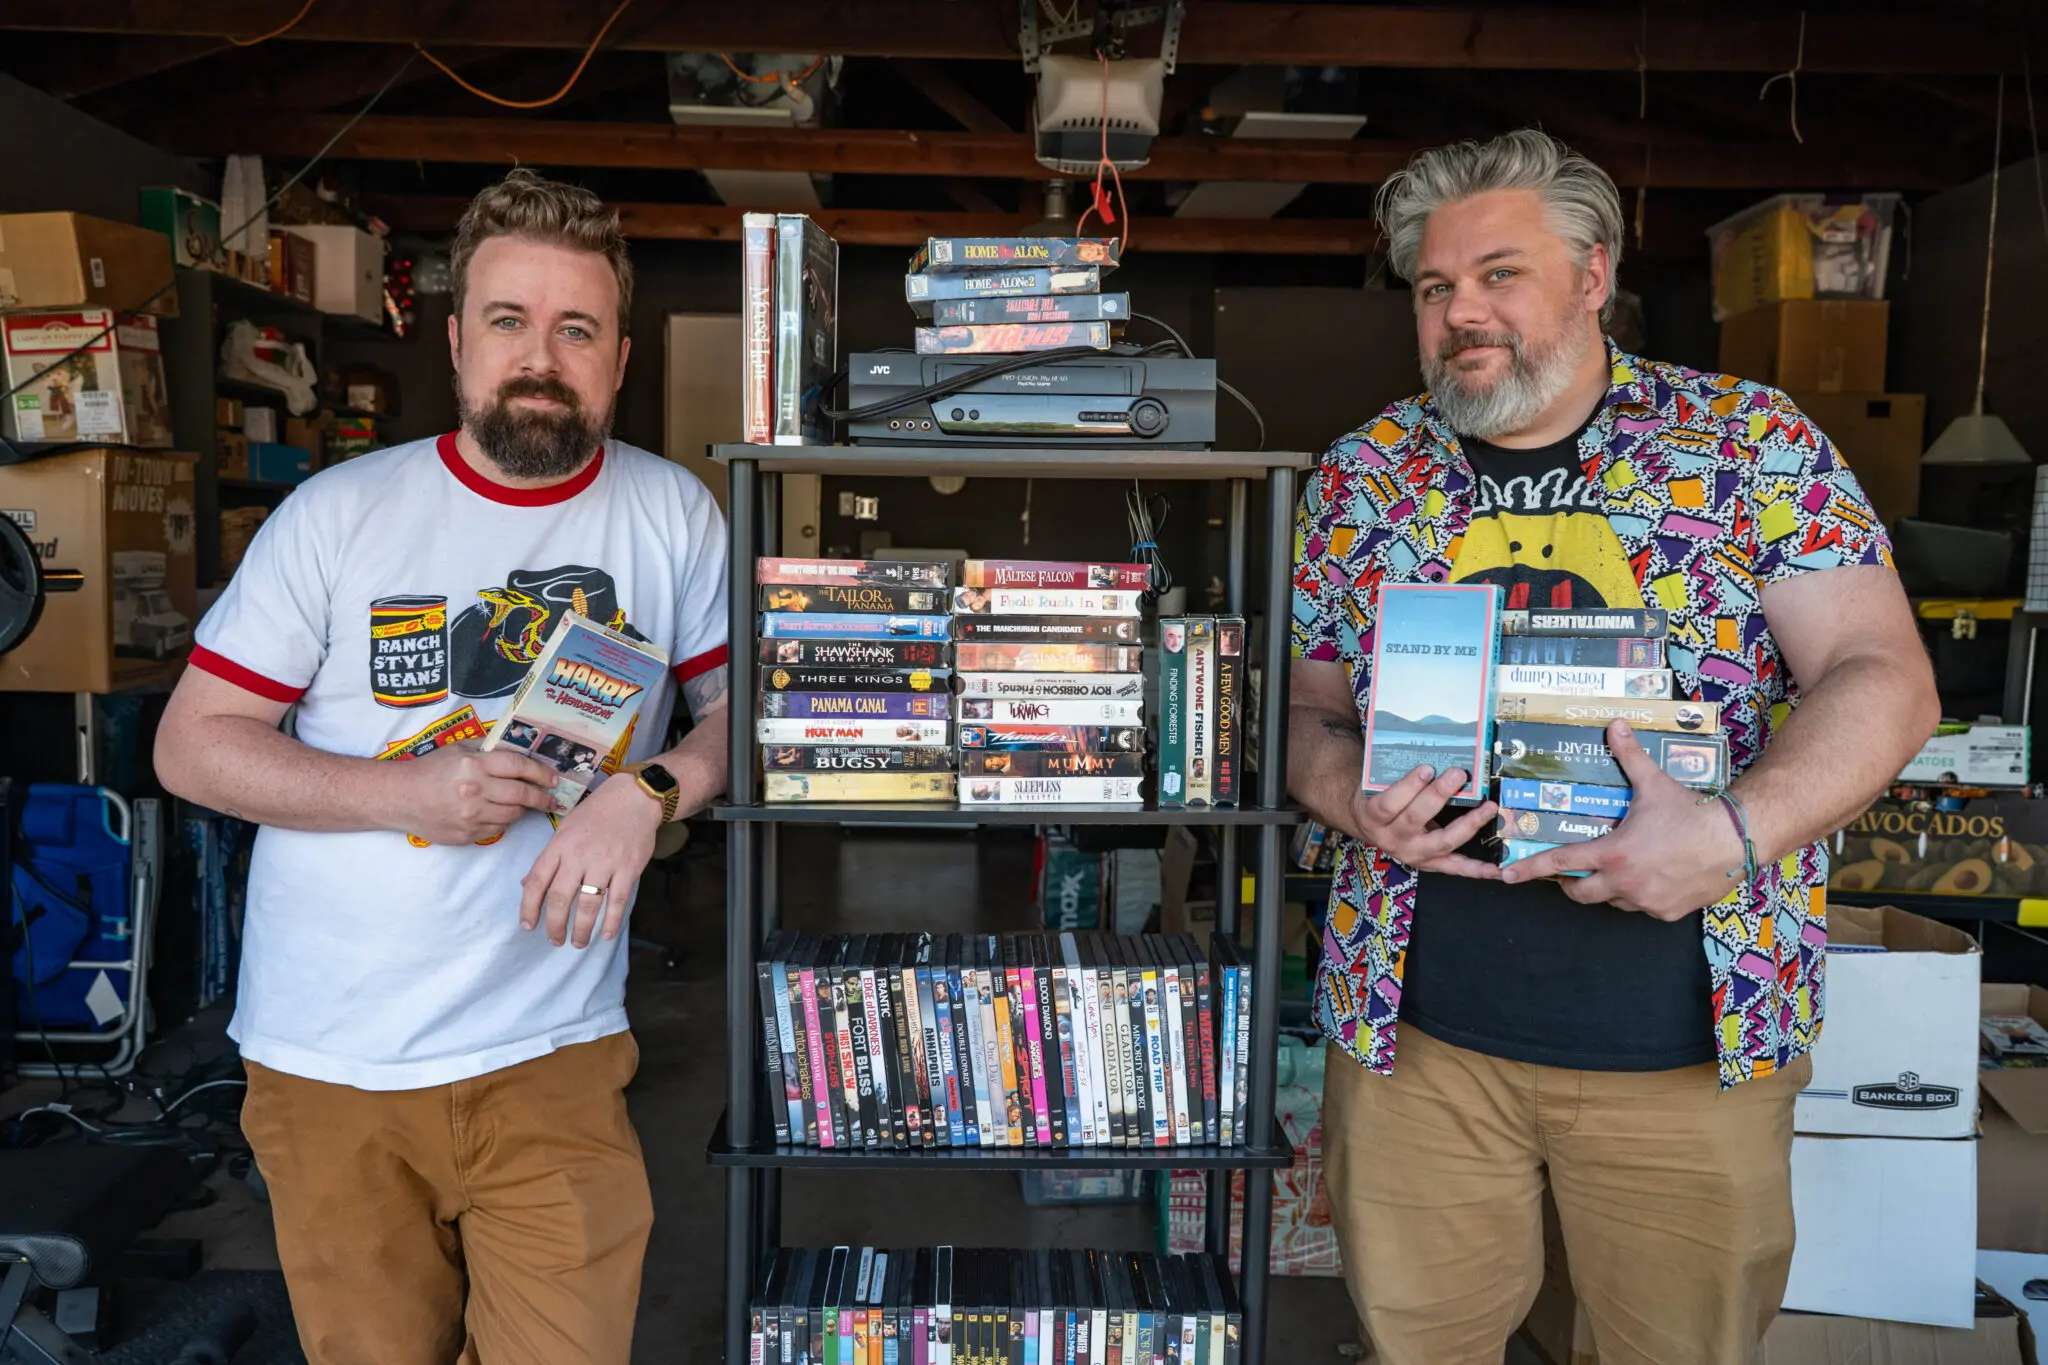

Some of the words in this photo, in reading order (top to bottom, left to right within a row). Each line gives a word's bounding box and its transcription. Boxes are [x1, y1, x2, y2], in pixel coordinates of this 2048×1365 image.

[964, 245, 999, 259] HOME
[964, 278, 992, 289] HOME
[1006, 300, 1039, 313] FUGITIVE
[1041, 298, 1055, 312] THE
[987, 326, 1073, 347] SPEED
[870, 365, 890, 375] JVC
[112, 484, 165, 513] MOVES
[995, 568, 1037, 584] MALTESE
[1038, 571, 1075, 587] FALCON
[826, 587, 883, 603] TAILOR
[1000, 595, 1034, 607] Fools
[1039, 596, 1074, 608] Rush
[1080, 597, 1094, 608] In
[848, 600, 895, 610] PANAMA
[993, 625, 1040, 633] MANCHURIAN
[1041, 625, 1083, 633] CANDIDATE
[1532, 615, 1635, 630] WINDTALKERS
[378, 635, 440, 653] RANCH
[815, 646, 895, 658] SHAWSHANK
[1386, 643, 1431, 655] STAND
[1433, 645, 1452, 656] BY
[1454, 646, 1478, 657] ME
[374, 650, 446, 670] STYLE
[1221, 662, 1231, 670] A
[377, 668, 441, 687] BEANS
[547, 657, 645, 708] HARRY
[800, 675, 847, 683] THREE
[854, 675, 903, 684] KINGS
[1169, 668, 1178, 702] FINDING
[1195, 649, 1205, 711] ANTWONE
[1221, 671, 1232, 694] FEW
[1510, 668, 1552, 685] Gump
[1556, 670, 1607, 691] Forrest
[998, 682, 1034, 694] Friends
[1035, 685, 1042, 695] &
[1043, 685, 1089, 696] ORBISON
[1090, 686, 1112, 696] ROY
[556, 690, 614, 720] HENDERSONS
[811, 698, 853, 713] PANAMA
[855, 698, 888, 714] CANAL
[1009, 702, 1051, 721] TURNING
[1220, 695, 1231, 731] GOOD
[1565, 706, 1653, 723] SIDEKICKS
[805, 726, 835, 738] HOLY
[836, 728, 863, 738] MAN
[1169, 703, 1178, 745] FORRESTER
[988, 731, 1078, 743] Thunder
[1194, 712, 1204, 756] FISHER
[1220, 732, 1230, 756] MEN
[816, 758, 892, 769] BUGSY
[1048, 754, 1115, 770] MUMMY
[1554, 755, 1610, 766] GIBSON
[1014, 780, 1062, 793] SLEEPLESS
[1575, 796, 1609, 806] BALOO
[1558, 820, 1599, 837] Harry
[1852, 810, 2005, 838] AVOCADOS
[803, 979, 815, 997] he's
[863, 978, 874, 1001] EDGE
[1039, 978, 1050, 1006] BLOOD
[804, 996, 817, 1013] just
[866, 1001, 875, 1009] of
[877, 978, 891, 1018] FRANTIC
[895, 1002, 903, 1017] THE
[1087, 1001, 1098, 1019] Love
[868, 1009, 880, 1056] DARKNESS
[897, 1019, 906, 1037] THIN
[1041, 1007, 1052, 1040] DIAMOND
[1185, 1021, 1194, 1037] THE
[1238, 1015, 1250, 1034] BAD
[809, 1030, 821, 1046] that
[839, 1030, 850, 1051] FIRST
[851, 1017, 866, 1053] FORT
[956, 1024, 967, 1052] DOUBLE
[811, 1047, 822, 1065] into
[900, 1040, 908, 1054] RED
[940, 1032, 955, 1074] SCHOOL
[988, 1041, 997, 1058] One
[1061, 1041, 1070, 1062] HOTEL
[1132, 1024, 1143, 1073] MINORITY
[1150, 1035, 1161, 1066] ROAD
[1200, 1011, 1216, 1101] MECHANIC
[1237, 1034, 1249, 1065] COUNTRY
[796, 1030, 811, 1099] Intouchables
[824, 1032, 839, 1088] STOP-LOSS
[902, 1056, 911, 1074] LINE
[924, 1028, 941, 1087] ANNAPOLIS
[1029, 1040, 1039, 1079] ANGELS
[1105, 1024, 1119, 1097] GLADIATOR
[1121, 1024, 1134, 1097] GLADIATOR
[812, 1065, 823, 1081] you
[842, 1050, 856, 1090] SNOW
[856, 1056, 872, 1097] BLISS
[960, 1052, 971, 1087] JEOPARDY
[990, 1060, 999, 1085] Day
[1015, 1045, 1034, 1114] SPIRIT
[1063, 1065, 1077, 1097] RWANDA
[1152, 1068, 1163, 1093] TRIP
[1136, 1076, 1147, 1111] REPORT
[1860, 1092, 1923, 1102] BANKERS
[1926, 1093, 1952, 1102] BOX
[1068, 1322, 1076, 1339] YES
[1077, 1324, 1088, 1354] DEPARTED
[1140, 1328, 1152, 1348] ROB
[752, 1338, 761, 1359] ALONZO
[1068, 1341, 1076, 1361] MAN
